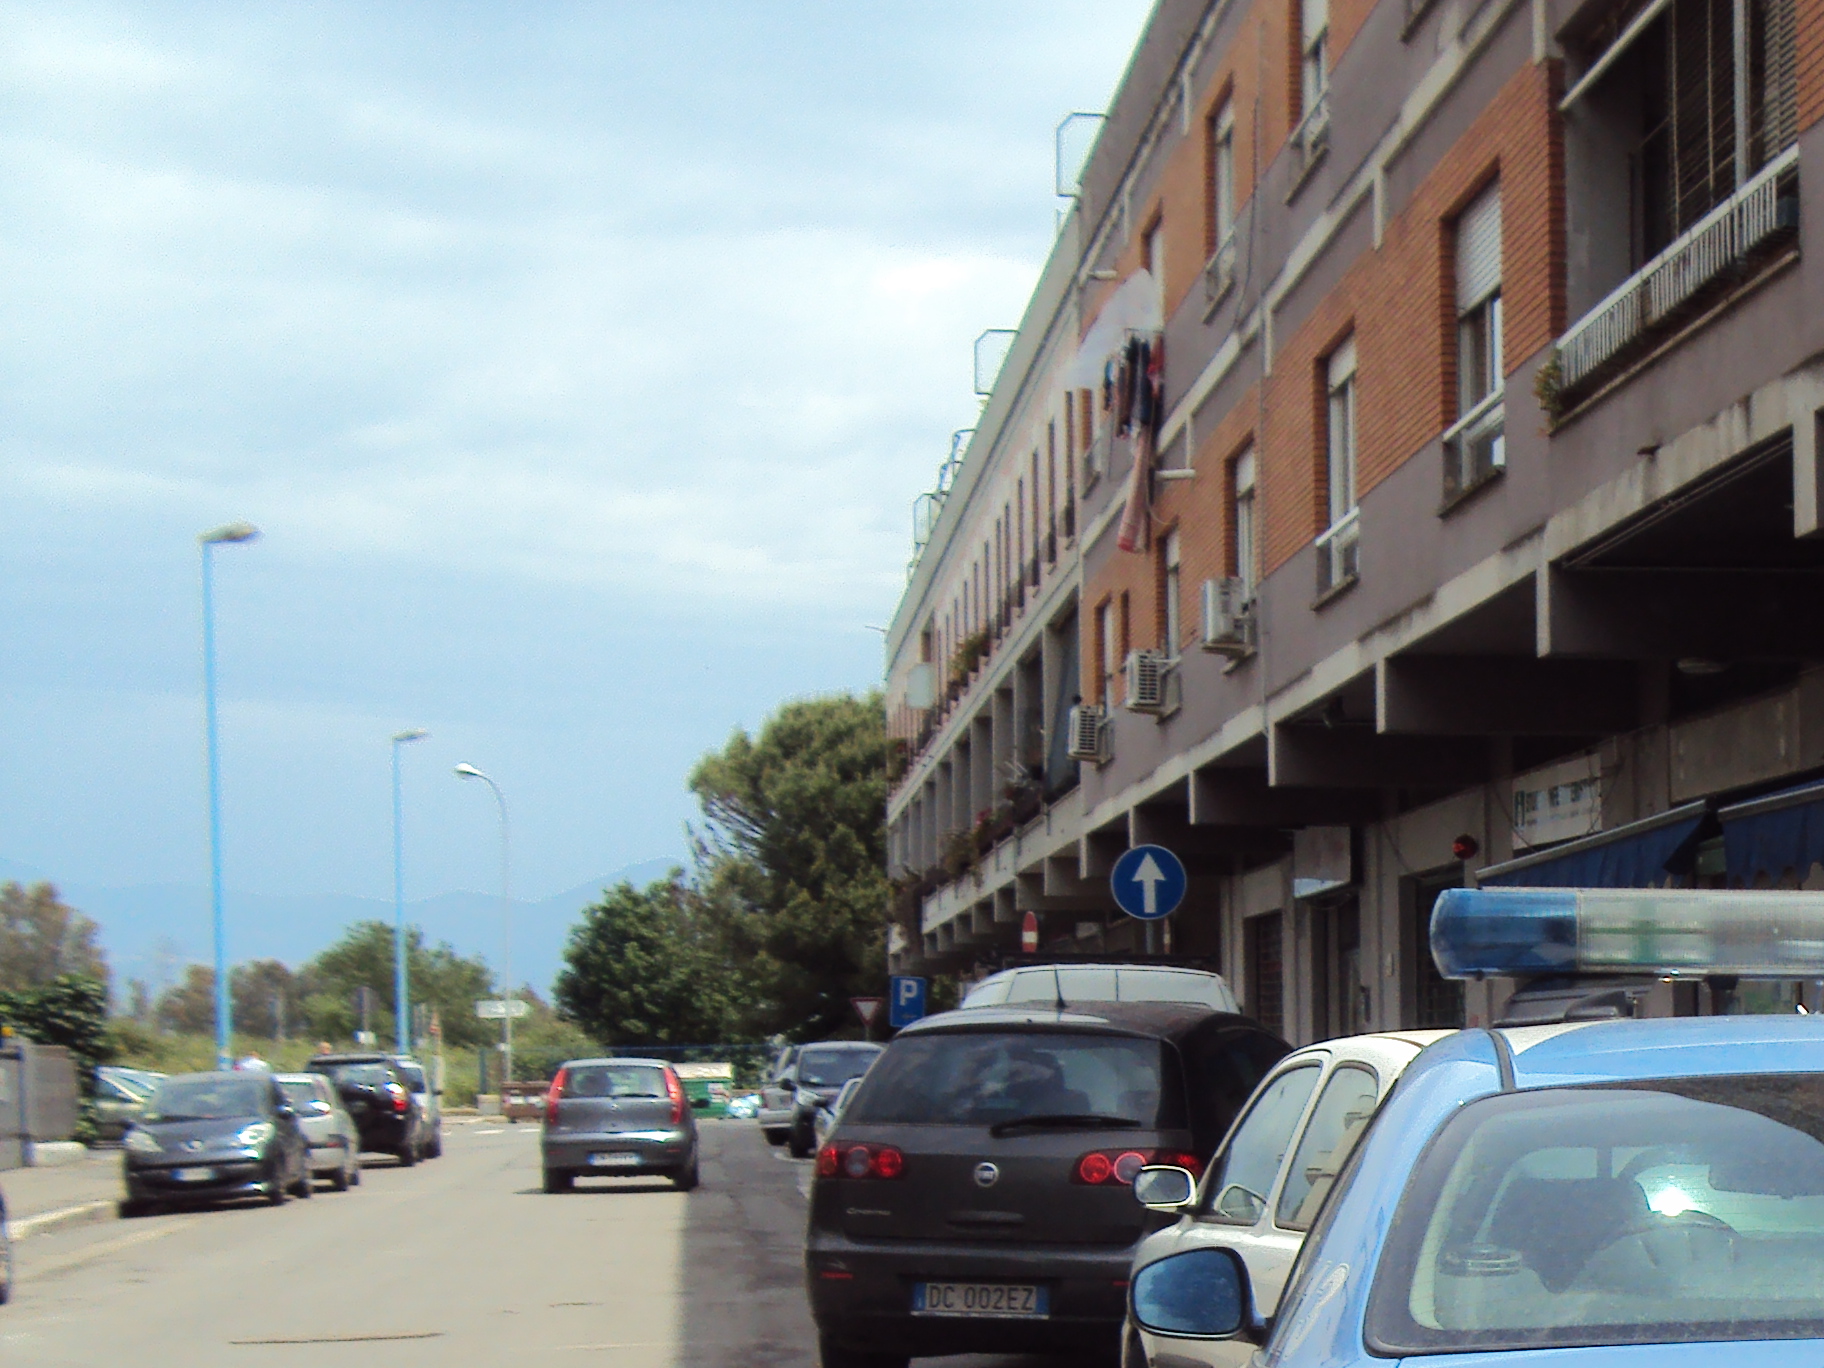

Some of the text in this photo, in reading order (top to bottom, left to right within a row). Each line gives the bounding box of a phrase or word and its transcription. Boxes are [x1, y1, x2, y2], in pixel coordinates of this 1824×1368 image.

[899, 979, 918, 1006] P
[928, 1284, 1034, 1311] DC 002EZ
